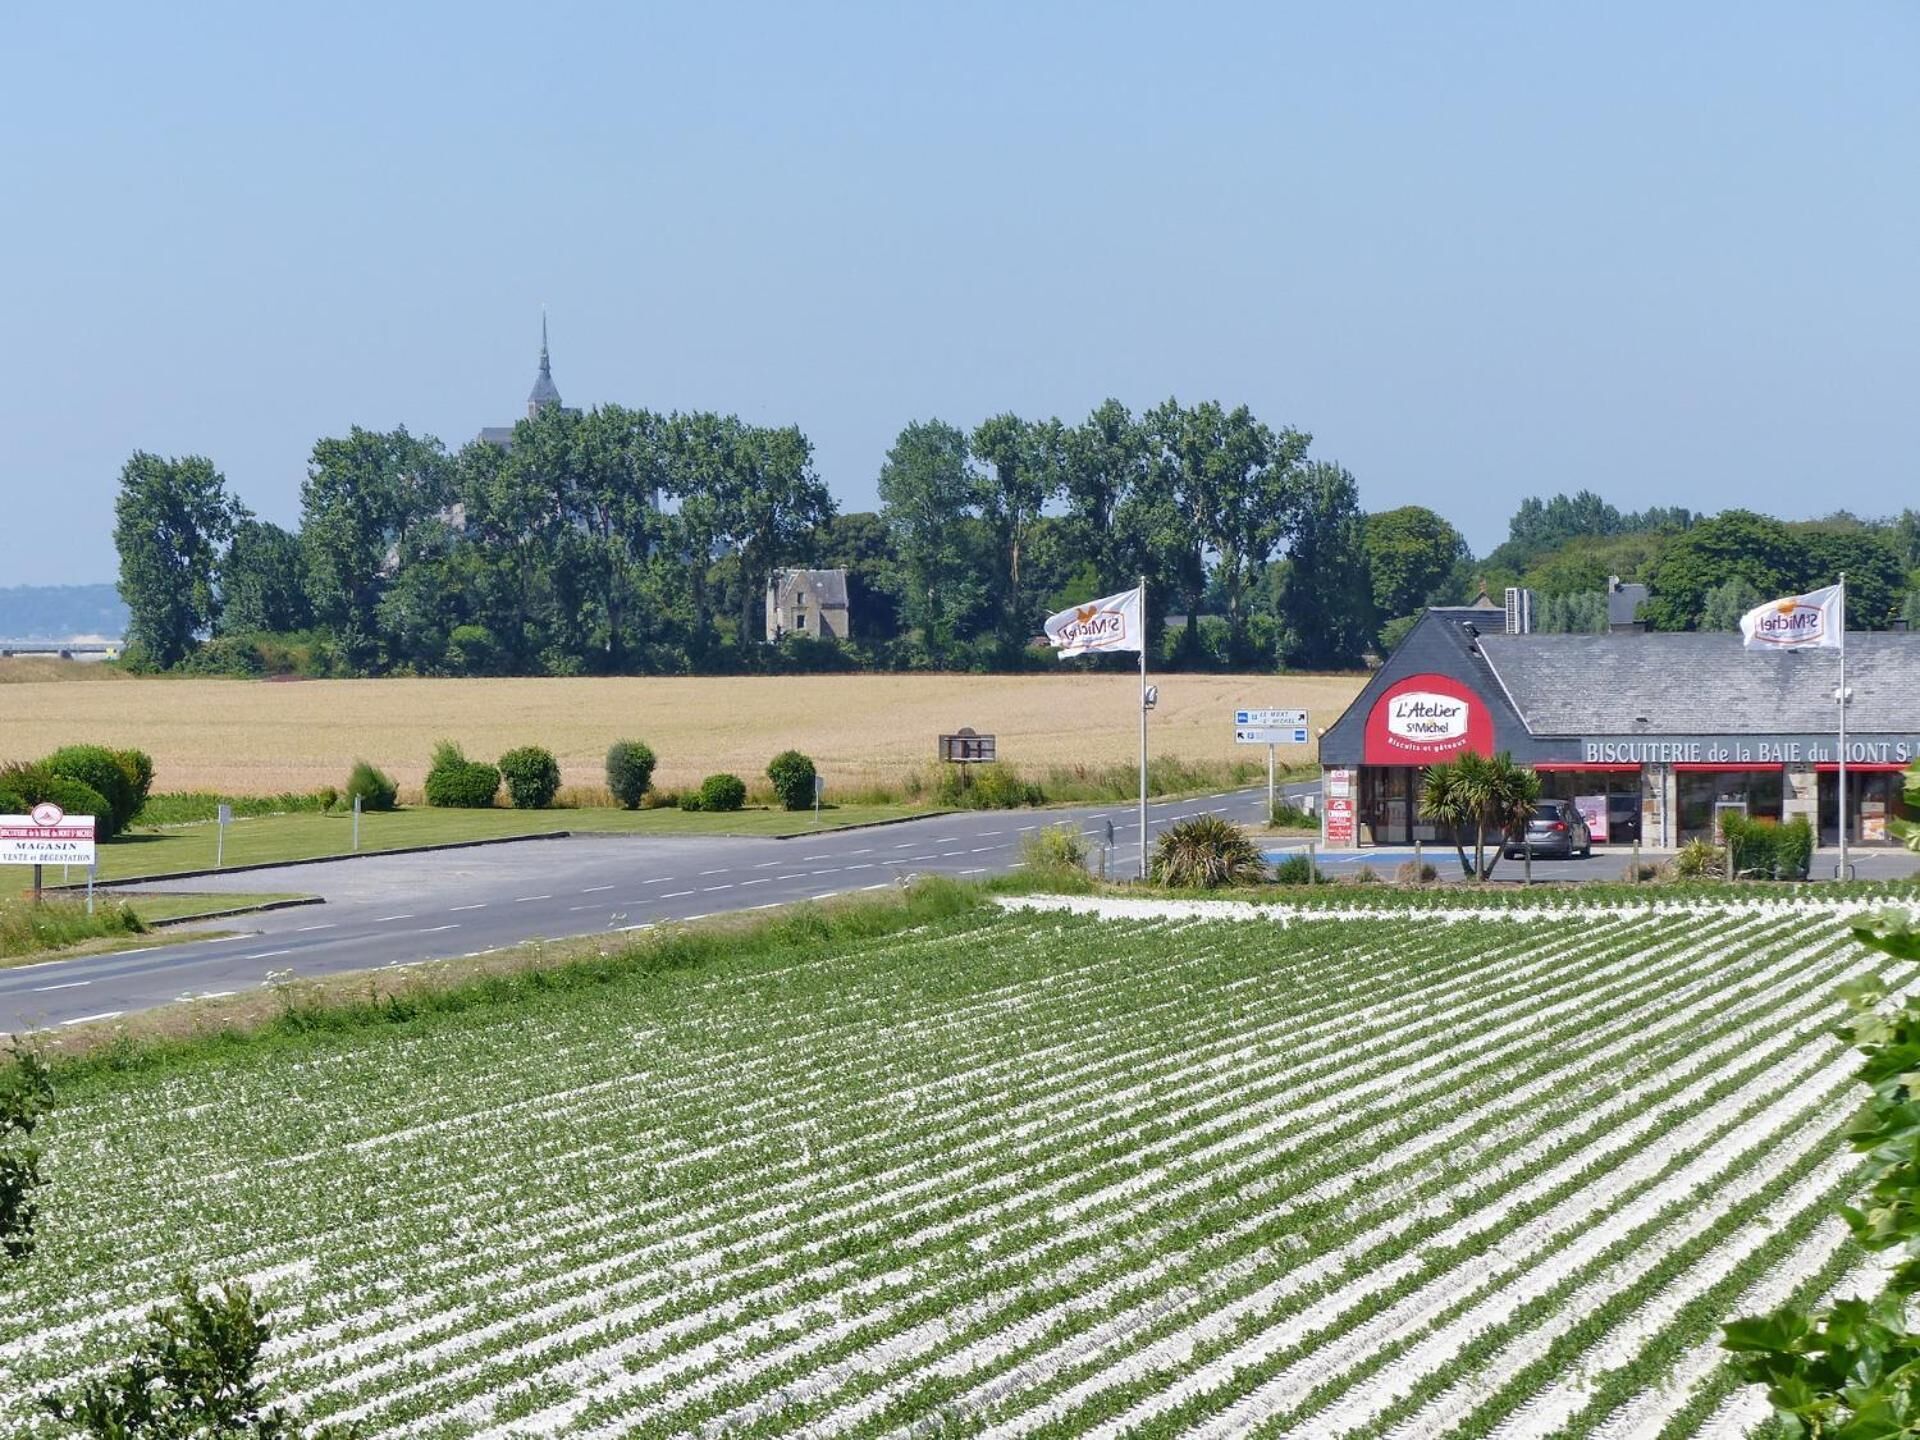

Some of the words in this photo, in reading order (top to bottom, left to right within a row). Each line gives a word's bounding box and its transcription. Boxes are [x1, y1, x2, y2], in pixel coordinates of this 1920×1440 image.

[1396, 702, 1461, 718] L'Atelier
[1586, 743, 1701, 763] BISCUITERIE
[1708, 742, 1729, 762] de
[1736, 742, 1751, 762] la
[1759, 742, 1801, 762] BAIE
[1808, 742, 1829, 762] du
